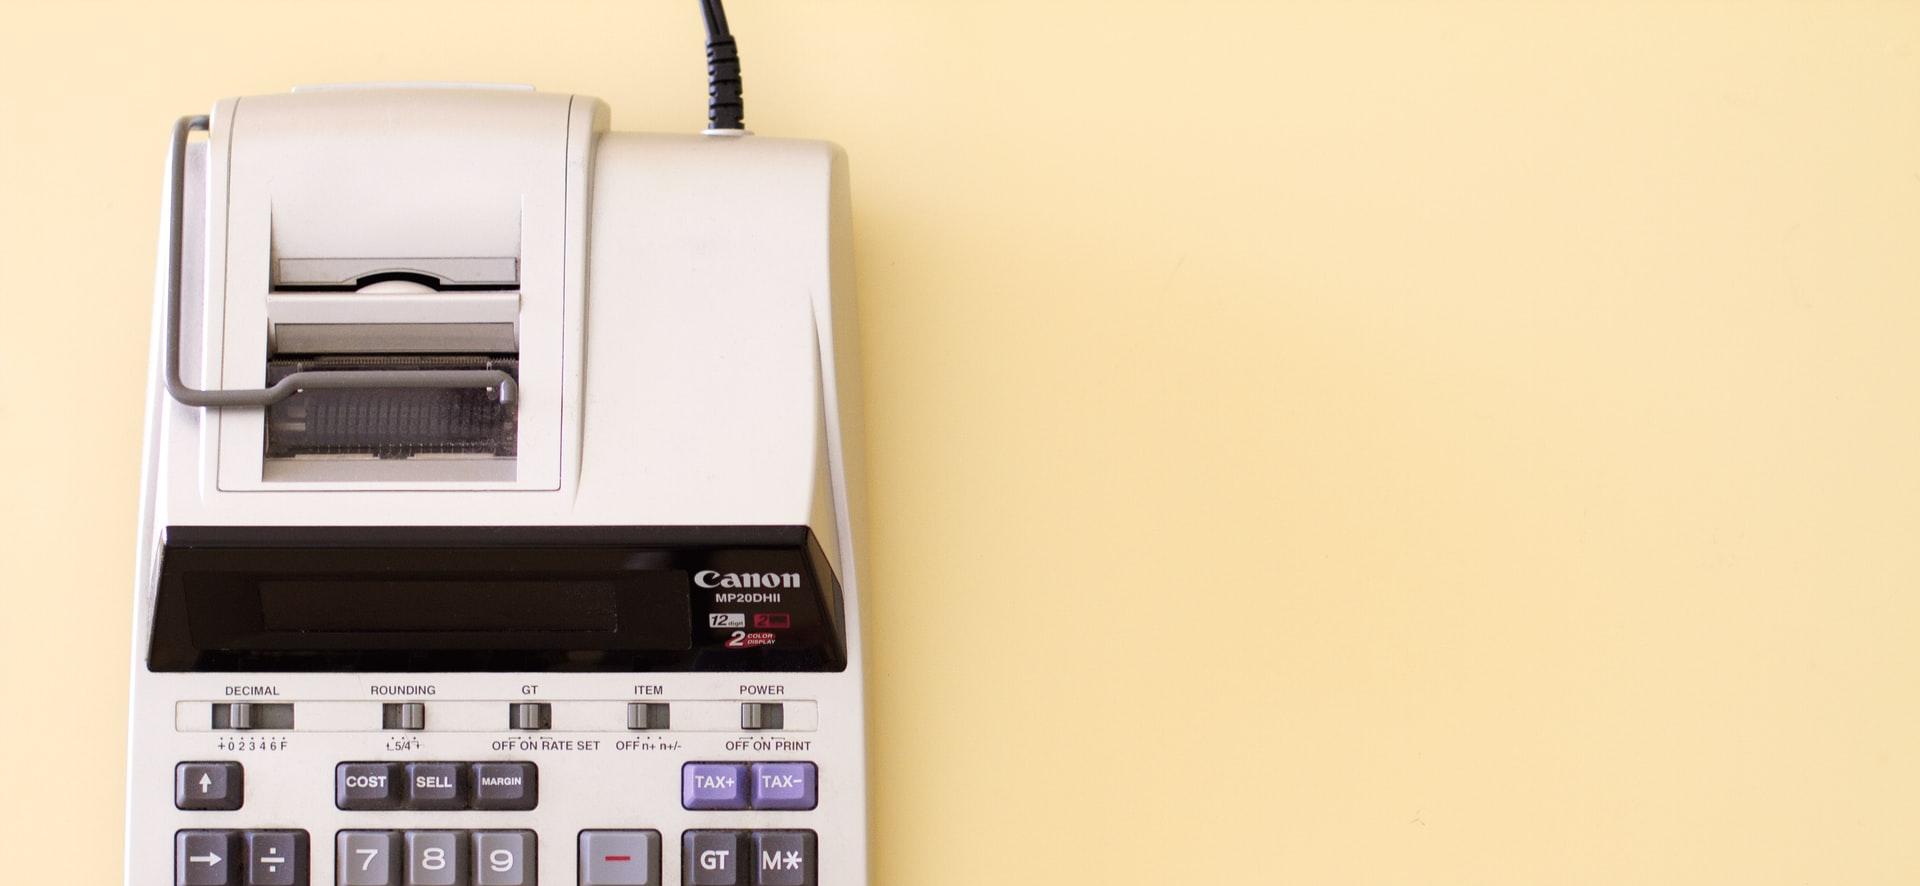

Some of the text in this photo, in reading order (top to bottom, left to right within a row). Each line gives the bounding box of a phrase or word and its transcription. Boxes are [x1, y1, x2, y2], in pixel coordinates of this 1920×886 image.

[694, 570, 800, 588] Canon
[716, 593, 780, 603] MP20DHII
[711, 615, 744, 628] 12 digit
[729, 631, 746, 646] 2
[225, 686, 279, 696] DECIMAL
[370, 685, 436, 696] ROUNDING
[522, 685, 538, 695] GT
[634, 685, 663, 695] ITEM
[740, 685, 784, 695] POWER
[238, 741, 245, 751] 2
[249, 741, 256, 751] 3
[259, 741, 266, 751] 4
[270, 741, 277, 751] 6
[280, 741, 287, 751] F
[492, 740, 600, 751] OFF ON RATE SET
[615, 740, 640, 751] OFF
[725, 740, 811, 751] OFF ON PRINT
[346, 775, 387, 788] COST
[416, 776, 452, 788] SELL
[482, 776, 522, 786] MARGIN
[695, 775, 735, 789] TAX+
[355, 849, 378, 871] 7
[421, 847, 447, 870] 8
[489, 849, 514, 872] 9
[700, 850, 729, 870] GT
